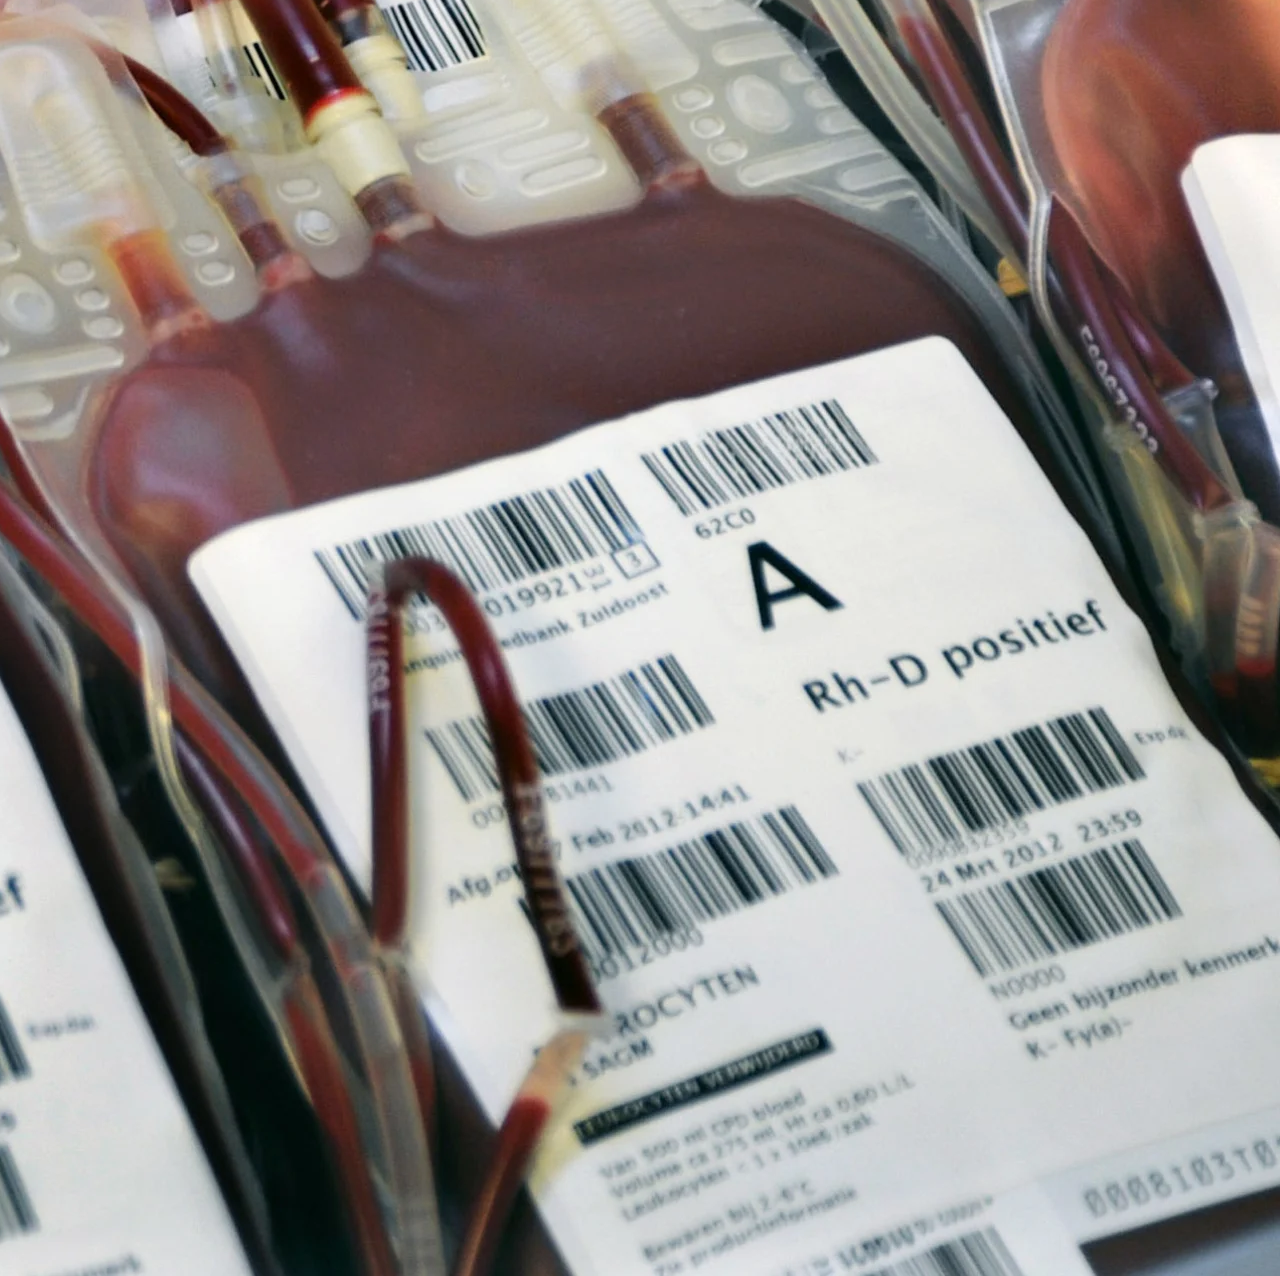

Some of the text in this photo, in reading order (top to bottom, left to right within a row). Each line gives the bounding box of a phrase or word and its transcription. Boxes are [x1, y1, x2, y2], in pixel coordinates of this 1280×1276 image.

[485, 574, 585, 617] 019921
[746, 539, 845, 631] A
[802, 598, 1110, 713] Rh-D positief
[920, 868, 952, 895] 24
[1009, 999, 1071, 1032] Geen
[1071, 965, 1180, 1015] bijzonder
